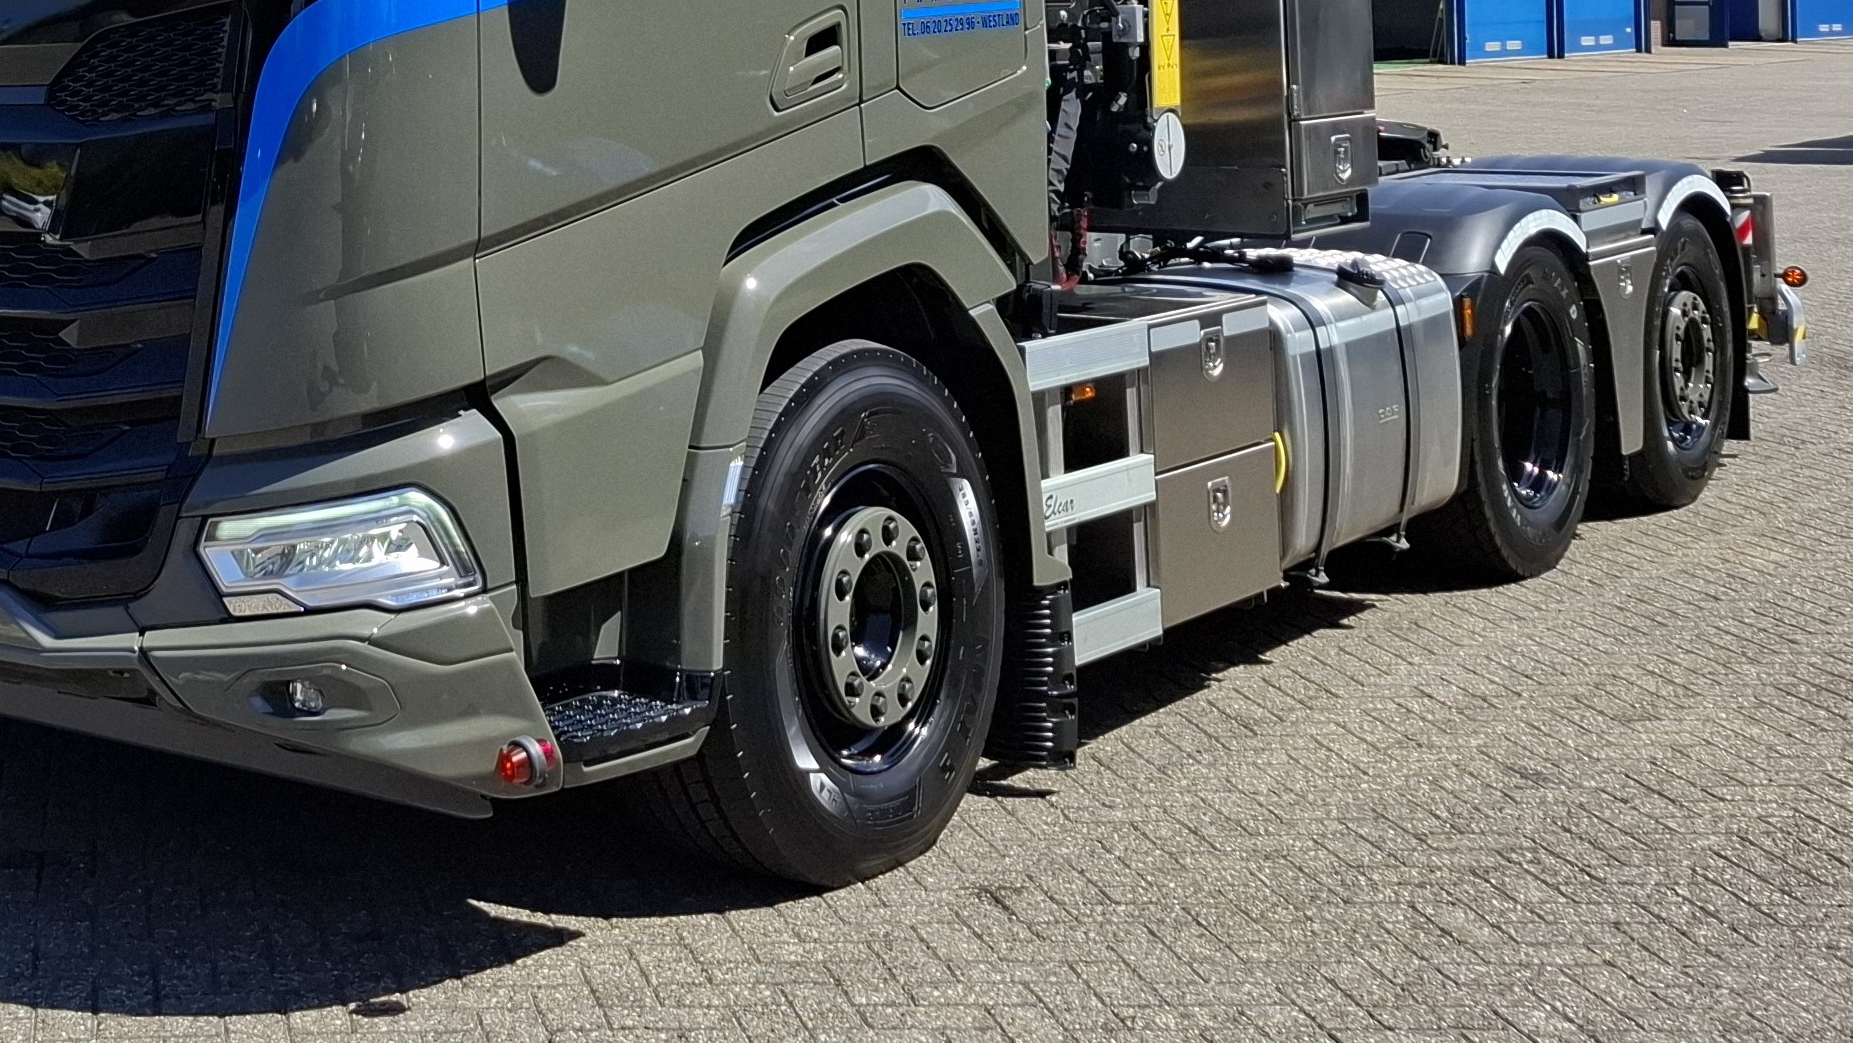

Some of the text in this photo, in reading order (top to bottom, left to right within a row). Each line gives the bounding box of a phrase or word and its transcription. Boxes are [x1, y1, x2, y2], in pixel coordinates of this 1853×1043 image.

[902, 22, 919, 37] TEL.
[920, 21, 931, 35] 06
[932, 20, 942, 33] 20
[944, 19, 953, 32] 25
[954, 17, 964, 31] 29
[966, 17, 975, 30] 96
[980, 13, 1020, 29] WESTLAND
